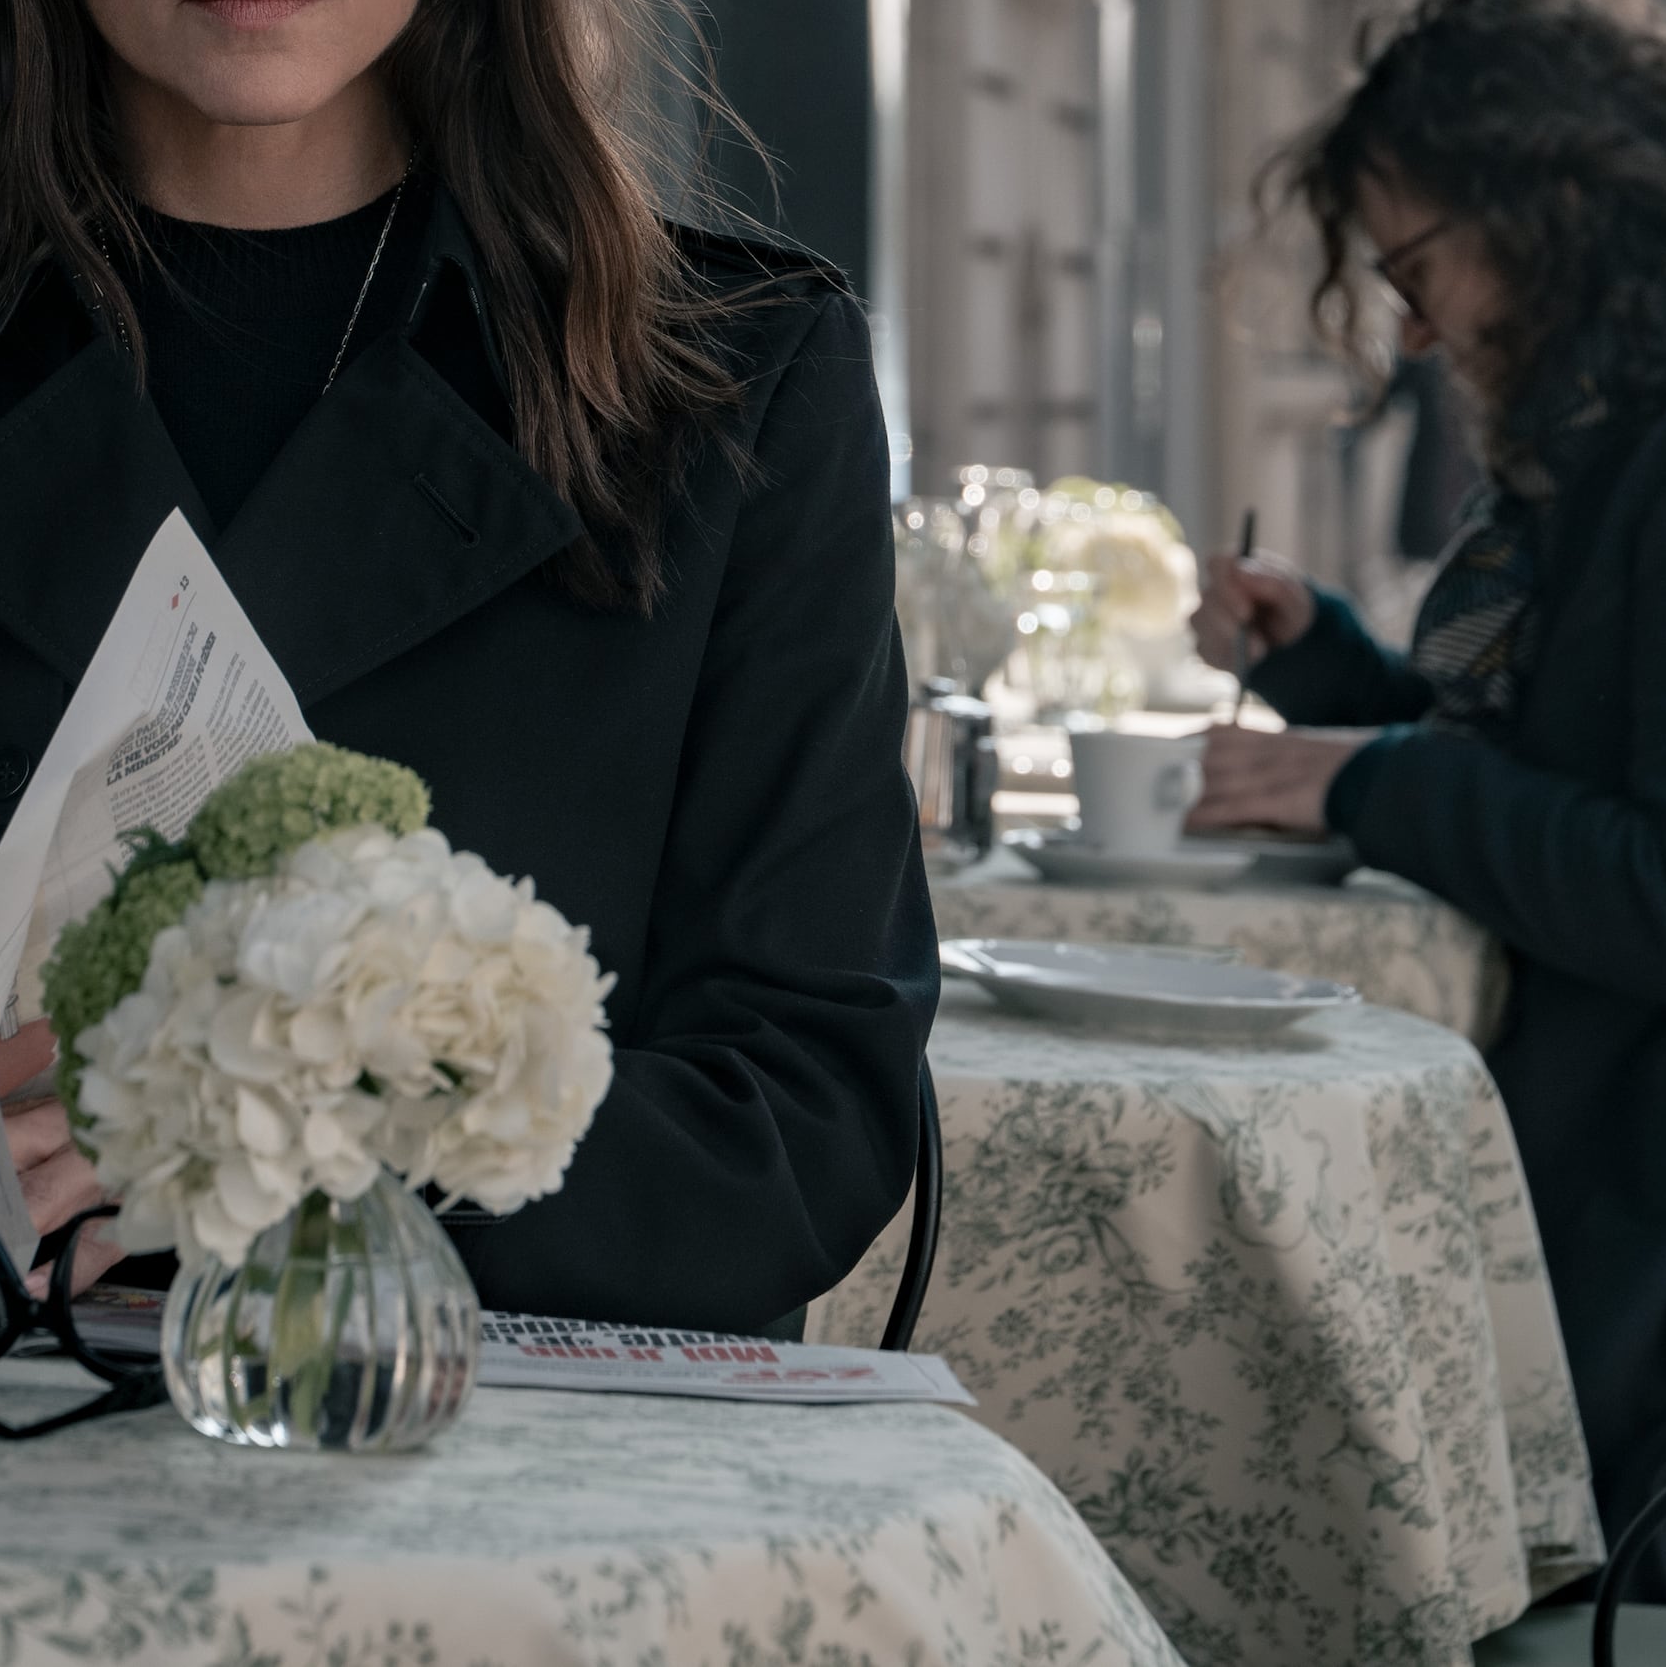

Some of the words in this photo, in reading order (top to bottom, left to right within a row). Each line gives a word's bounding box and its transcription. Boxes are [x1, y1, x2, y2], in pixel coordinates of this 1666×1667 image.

[179, 575, 190, 591] 13
[125, 749, 142, 765] NE
[144, 731, 170, 754] VOIS
[171, 711, 184, 736] PAS
[106, 771, 122, 787] LA
